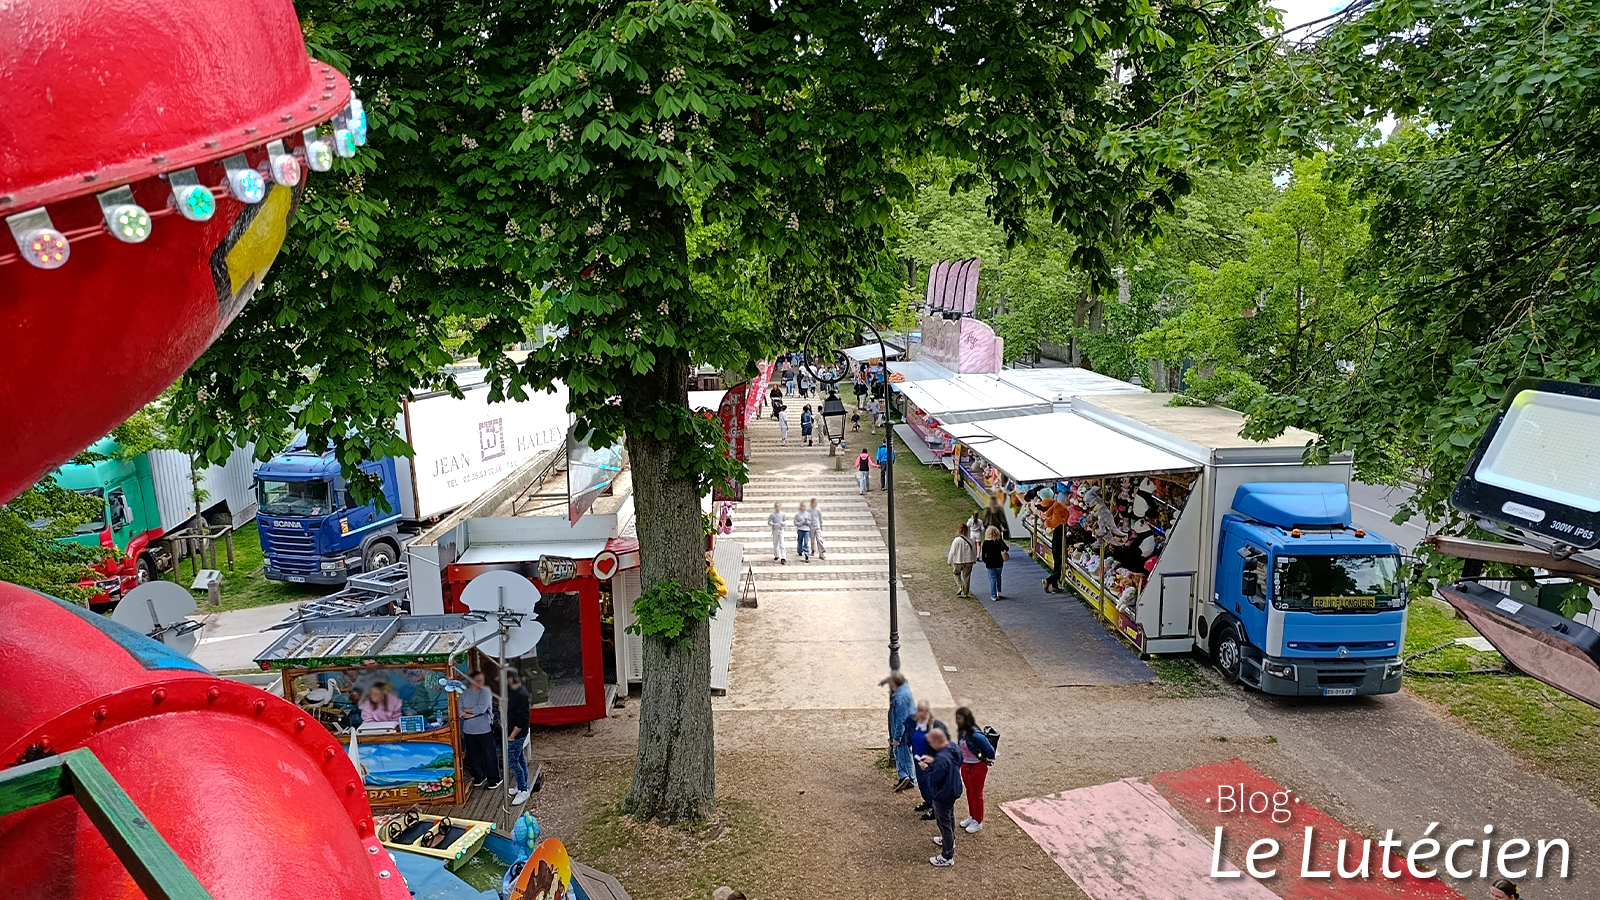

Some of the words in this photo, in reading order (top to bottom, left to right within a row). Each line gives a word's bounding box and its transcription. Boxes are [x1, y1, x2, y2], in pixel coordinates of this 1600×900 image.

[433, 452, 470, 477] JEAN
[517, 426, 562, 451] HALLEY
[1506, 505, 1541, 519] OPTONICA
[273, 520, 302, 528] SCANIA
[1550, 520, 1575, 534] 300W
[1573, 525, 1595, 540] IP65
[1314, 599, 1341, 608] GRANDE
[1340, 599, 1374, 608] LONGUEUR
